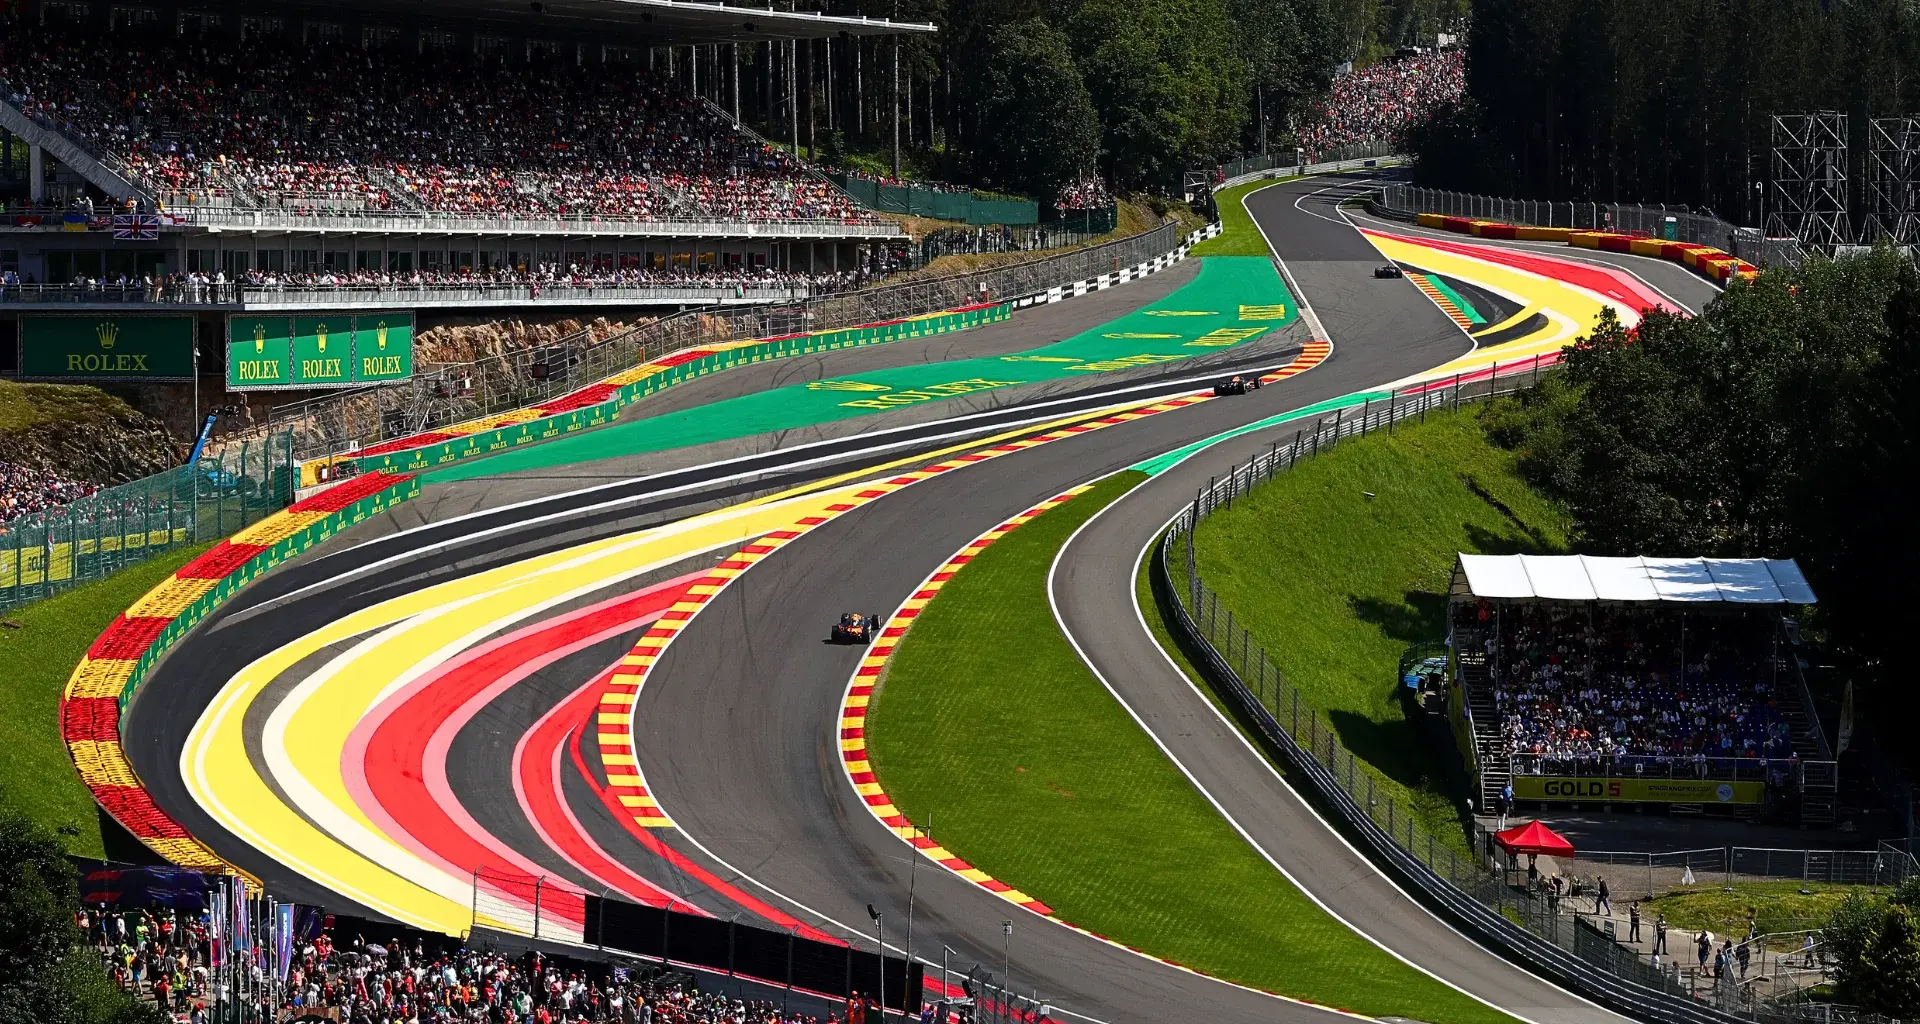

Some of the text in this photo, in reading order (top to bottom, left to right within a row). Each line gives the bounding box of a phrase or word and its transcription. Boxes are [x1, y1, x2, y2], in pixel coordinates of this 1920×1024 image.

[67, 354, 149, 371] ROLEX
[363, 355, 402, 376] ROLEX
[239, 360, 280, 380] ROLEX
[302, 358, 342, 378] ROLEX
[838, 378, 1027, 410] ROLEX
[590, 417, 605, 426] ROLEX
[566, 423, 582, 432] ROLEX
[543, 428, 559, 438] ROLEX
[516, 435, 533, 444] ROLEX
[490, 441, 508, 450] ROLEX
[463, 448, 481, 457] ROLEX
[439, 454, 455, 463] ROLEX
[408, 460, 429, 469] ROLEX
[1544, 781, 1621, 797] GOLD 5
